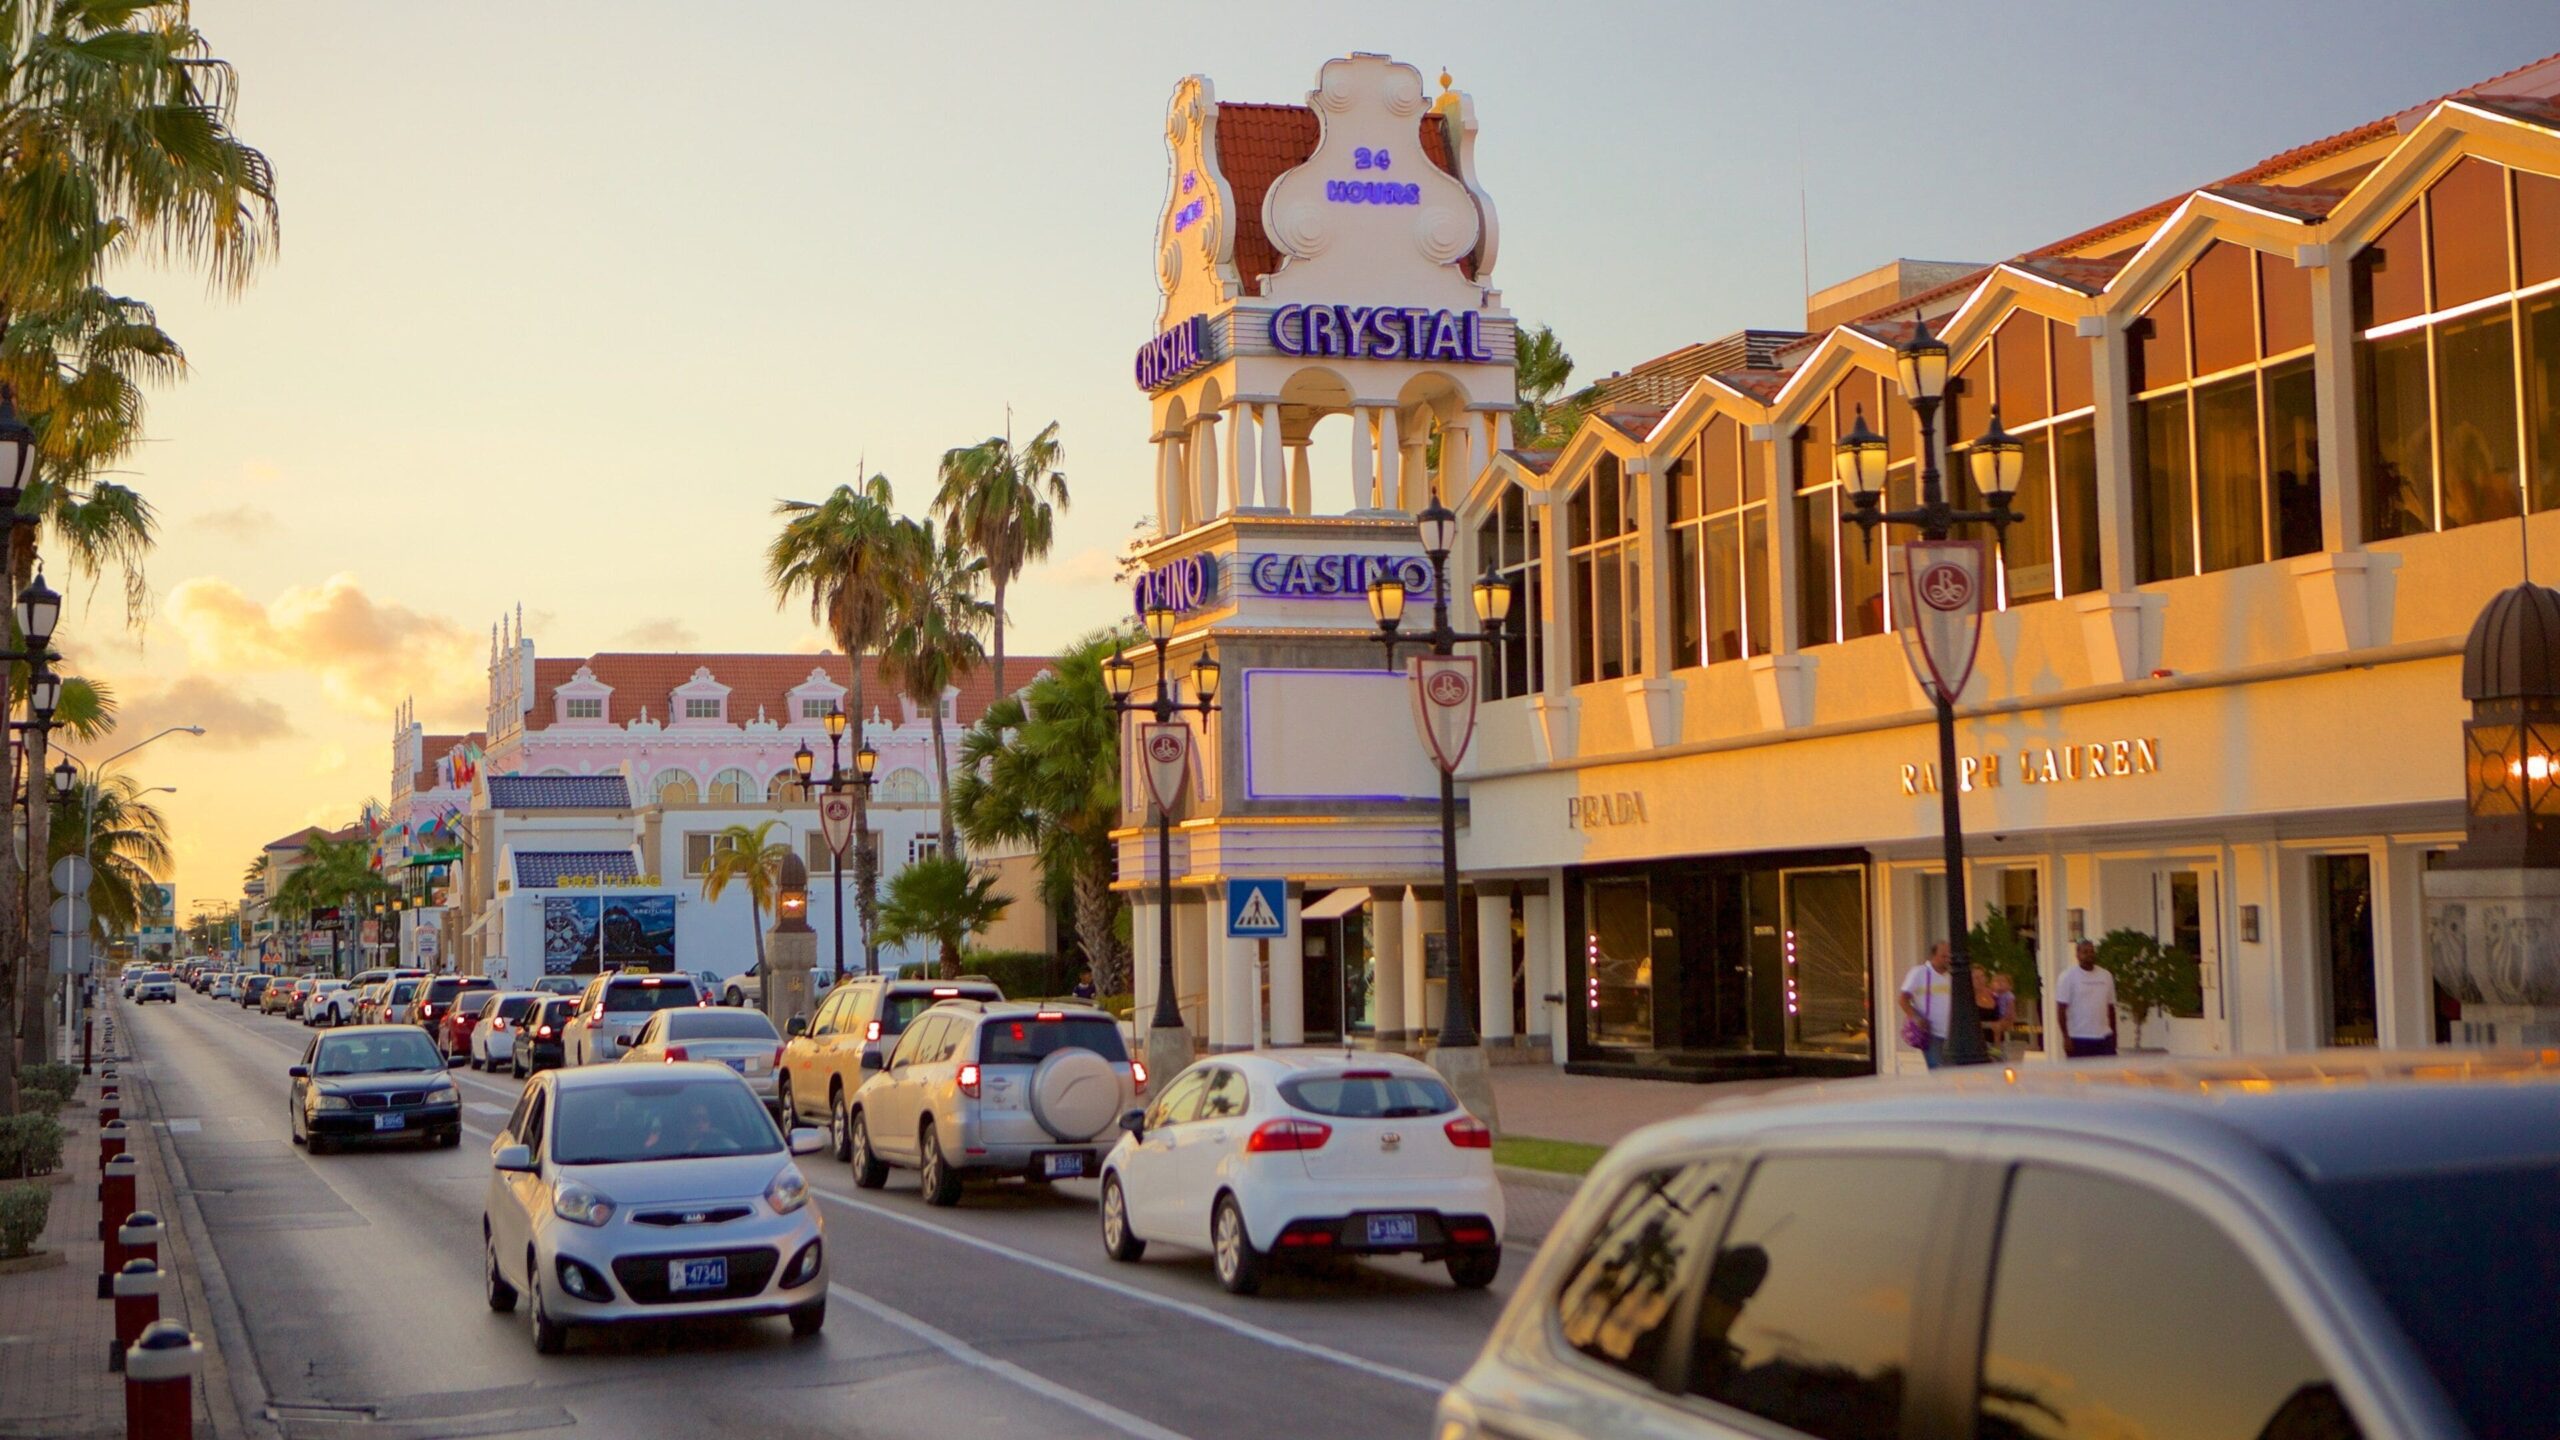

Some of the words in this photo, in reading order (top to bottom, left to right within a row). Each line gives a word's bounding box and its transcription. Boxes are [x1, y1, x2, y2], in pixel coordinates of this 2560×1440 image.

[1354, 147, 1391, 171] 24
[1326, 180, 1420, 205] HOURS
[1269, 304, 1492, 361] CRYSTAL
[1136, 314, 1201, 391] CRYSTAL
[1901, 754, 1998, 795] RAPH
[2020, 738, 2157, 784] LAUREN
[1568, 791, 1650, 828] PRADA
[558, 875, 662, 888] BRETLING
